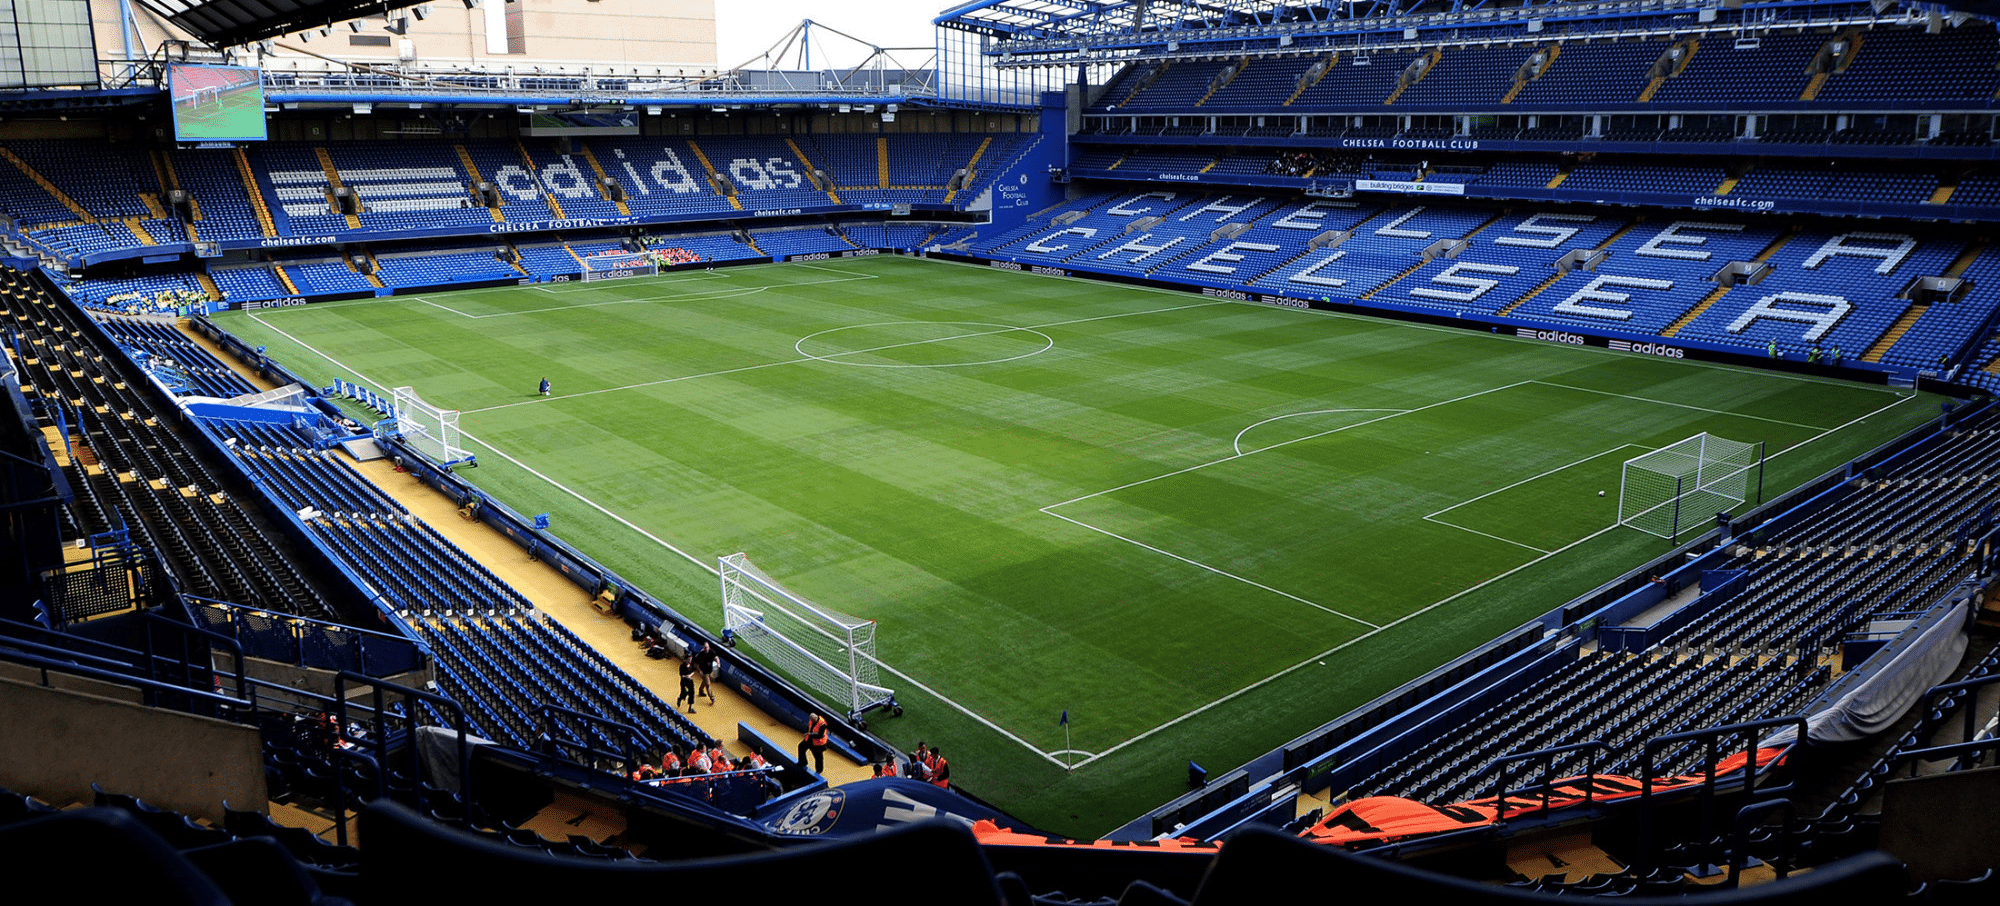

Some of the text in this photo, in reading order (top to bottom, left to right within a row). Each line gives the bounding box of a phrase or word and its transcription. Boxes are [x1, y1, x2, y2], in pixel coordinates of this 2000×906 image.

[1342, 139, 1478, 149] CHELSEA FOOTBALL CLUB
[496, 147, 802, 201] adidas
[1159, 173, 1199, 181] chelseafc.com
[998, 184, 1019, 192] CHELSEA
[1370, 182, 1392, 190] building
[1393, 183, 1414, 192] bridges
[1016, 198, 1029, 206] CLUB
[1694, 196, 1775, 209] chelseafc.com
[754, 208, 802, 217] chelseafc.com
[490, 224, 540, 233] CHELSEA
[549, 218, 604, 229] FOOTBALL
[1107, 191, 1917, 275] CHELSEA
[261, 235, 336, 247] chelseafc.com
[803, 253, 829, 261] adidas
[999, 261, 1022, 271] adidas
[1042, 267, 1065, 276] adidas
[601, 269, 634, 278] adidas
[1025, 227, 1854, 342] CHELSEA
[1216, 288, 1247, 301] adidas
[262, 297, 307, 308] adidas
[1276, 297, 1310, 309] adidas
[1538, 330, 1585, 345] adidas
[1632, 342, 1684, 359] adidas
